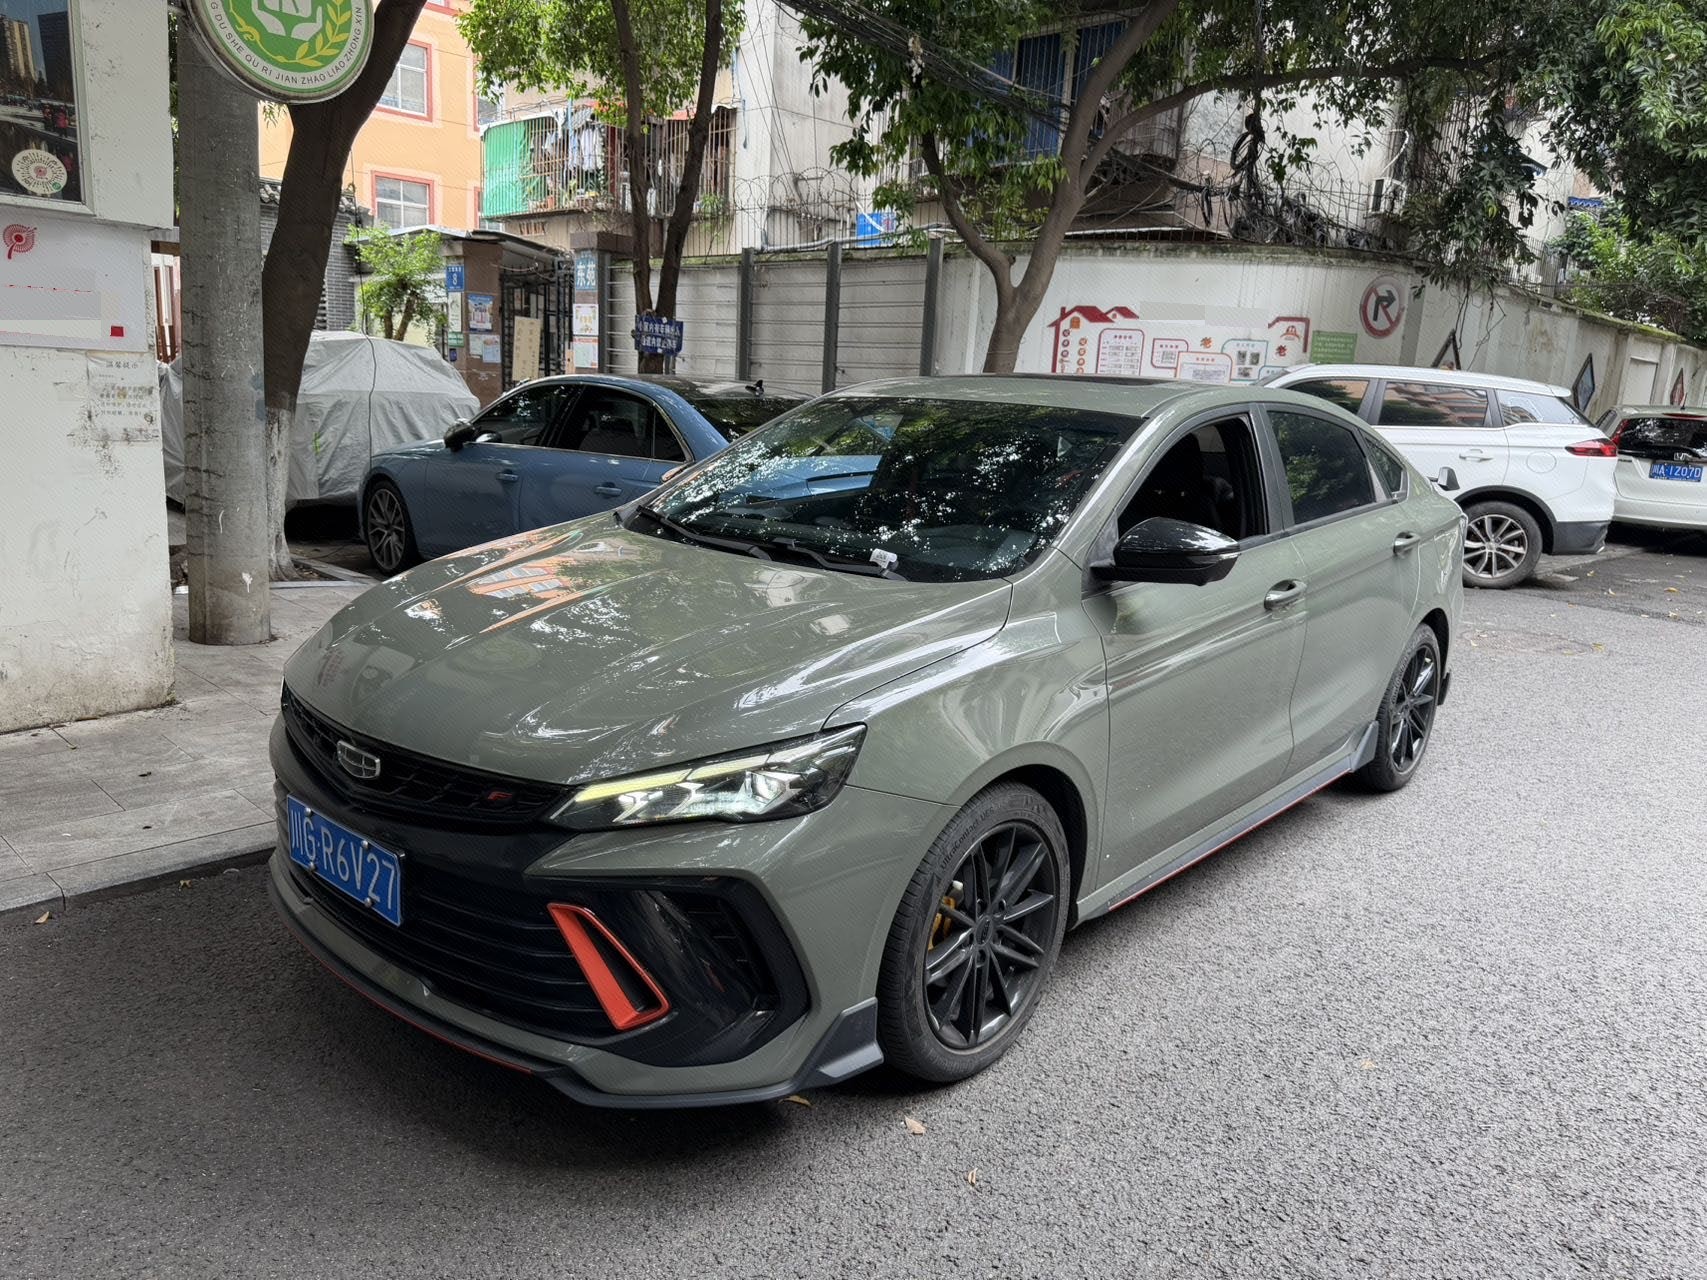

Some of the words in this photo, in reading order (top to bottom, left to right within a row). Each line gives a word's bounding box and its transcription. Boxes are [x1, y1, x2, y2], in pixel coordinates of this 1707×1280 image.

[215, 14, 227, 30] DU
[226, 32, 244, 54] SHE
[245, 54, 259, 68] QU
[261, 66, 272, 76] RI
[275, 73, 298, 84] JIAN
[301, 73, 326, 85] ZHAO
[327, 60, 346, 78] LIAO
[344, 28, 361, 62] ZHONG
[355, 7, 363, 26] XIN
[452, 272, 458, 286] 8
